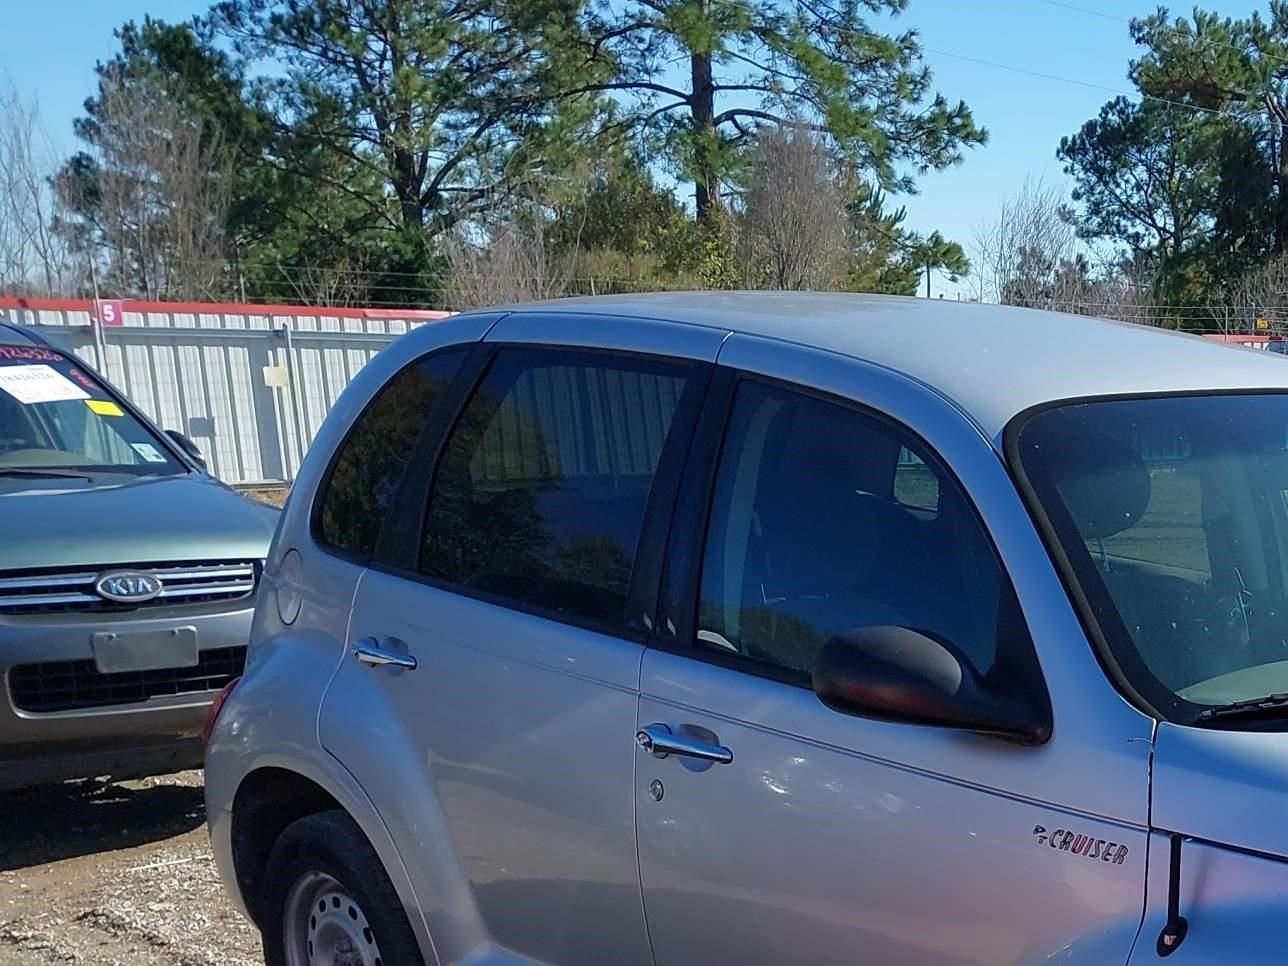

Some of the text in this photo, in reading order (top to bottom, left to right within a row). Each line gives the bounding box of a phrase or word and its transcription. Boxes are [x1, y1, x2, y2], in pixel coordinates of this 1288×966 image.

[102, 304, 115, 322] 5
[106, 577, 153, 594] KIA
[1048, 828, 1129, 865] CRUISER
